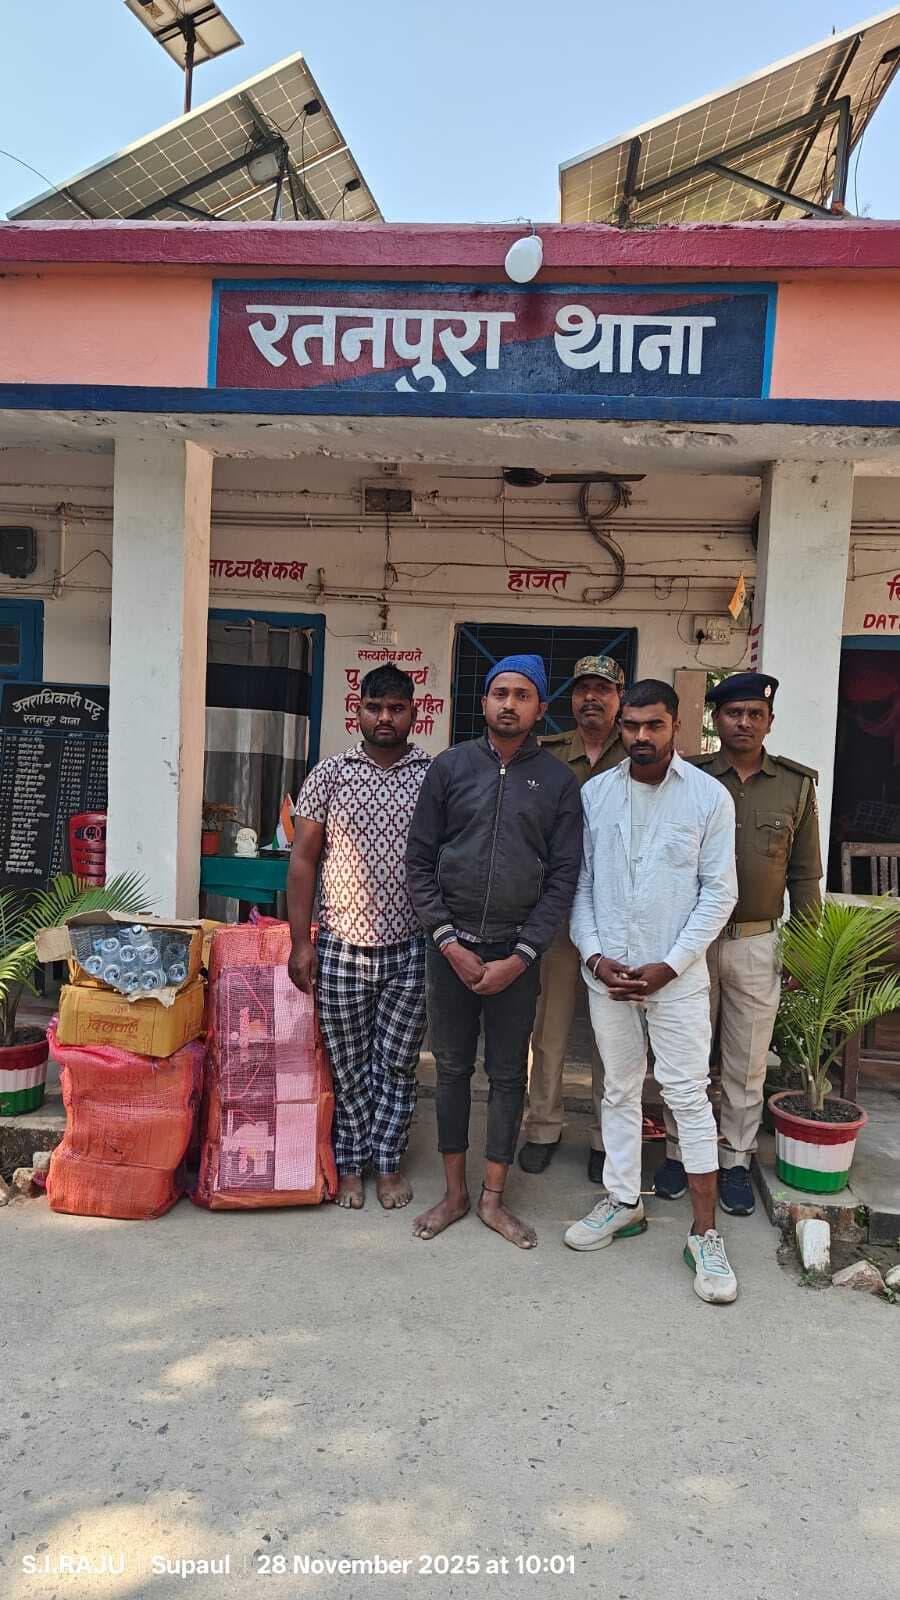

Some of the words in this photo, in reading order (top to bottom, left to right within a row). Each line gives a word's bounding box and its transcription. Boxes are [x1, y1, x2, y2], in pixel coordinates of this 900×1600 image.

[246, 304, 515, 392] रतनपुरा
[554, 304, 716, 375] थाना
[507, 568, 570, 593] हाजत
[863, 613, 900, 631] DAT
